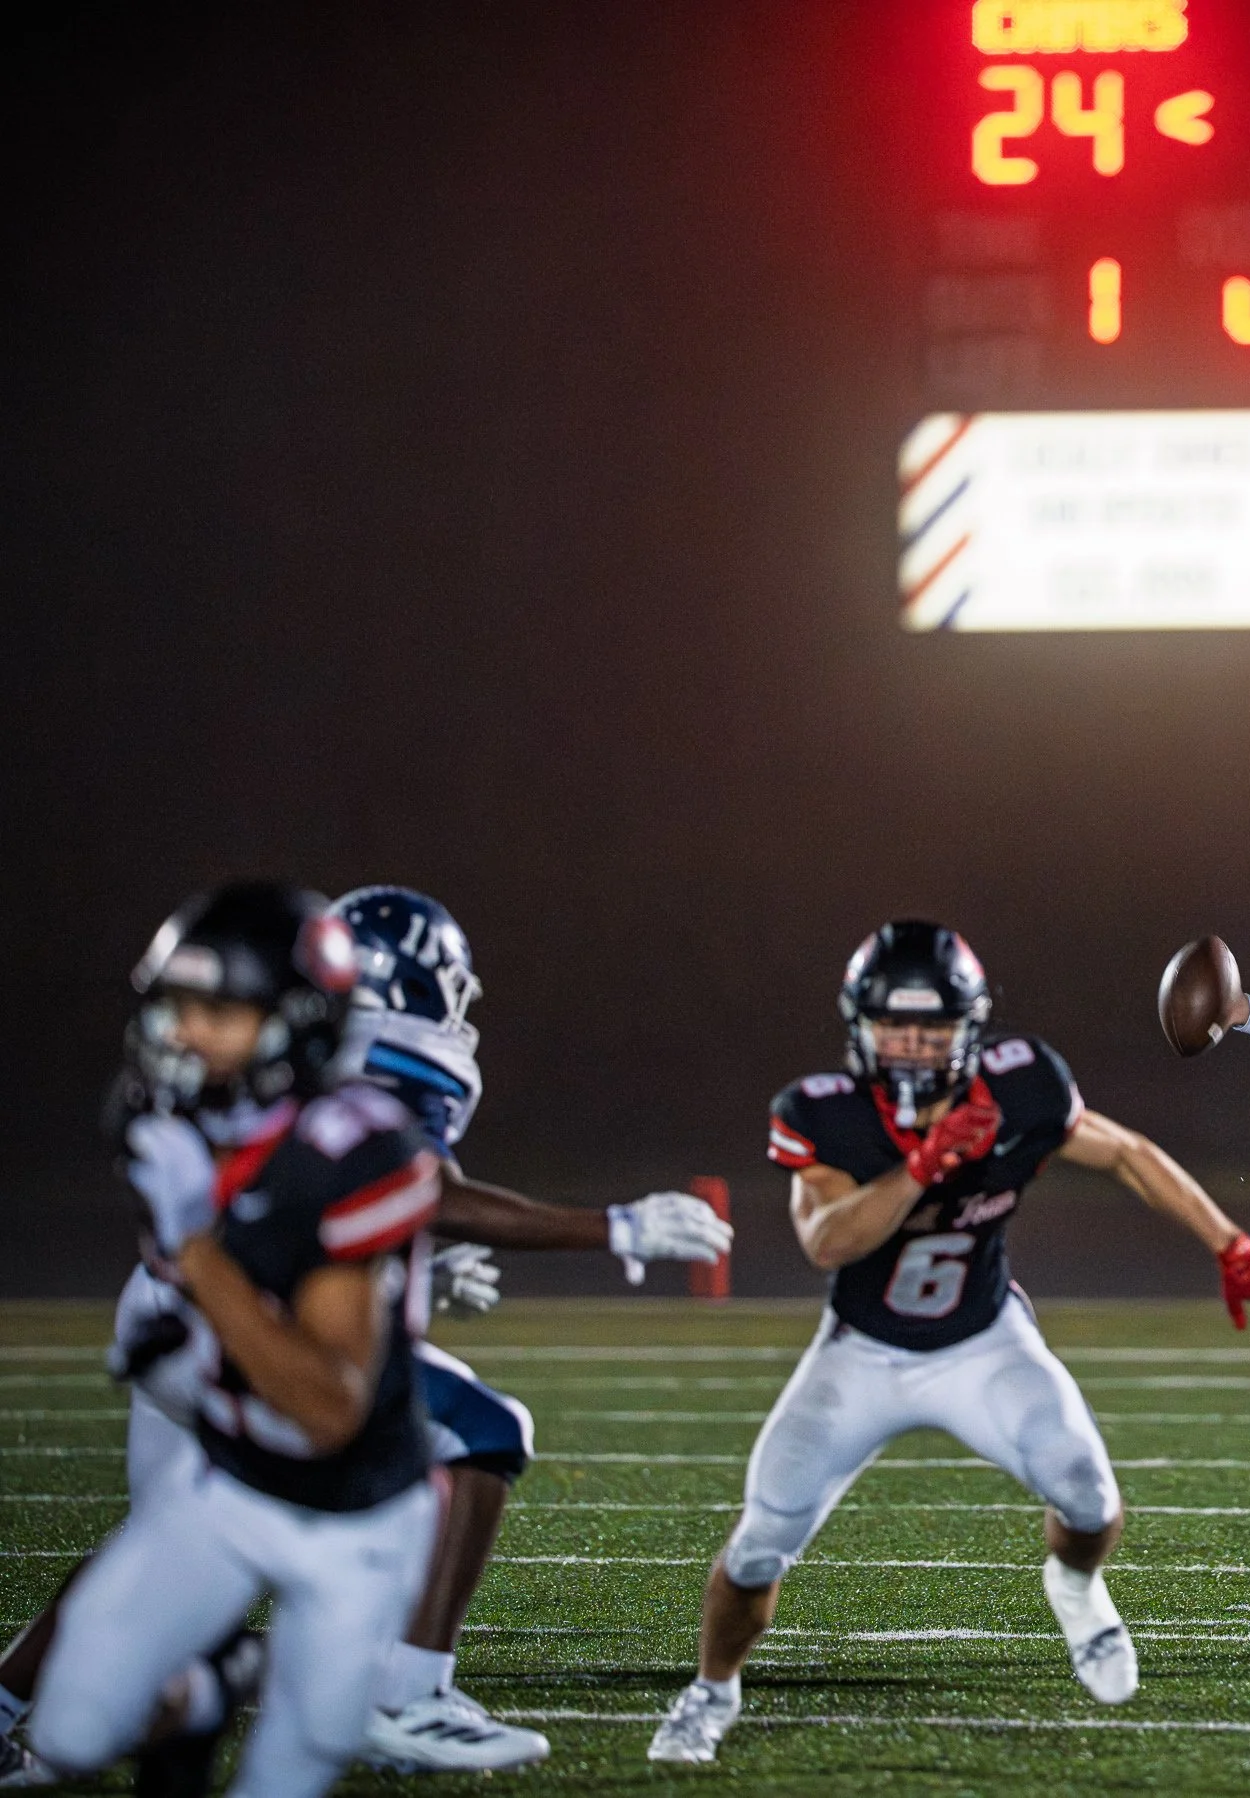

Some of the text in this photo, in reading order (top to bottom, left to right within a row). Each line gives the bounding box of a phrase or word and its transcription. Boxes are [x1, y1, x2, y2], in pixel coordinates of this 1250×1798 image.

[972, 65, 1124, 185] 24
[1089, 257, 1121, 344] 1
[884, 1231, 977, 1319] 6
